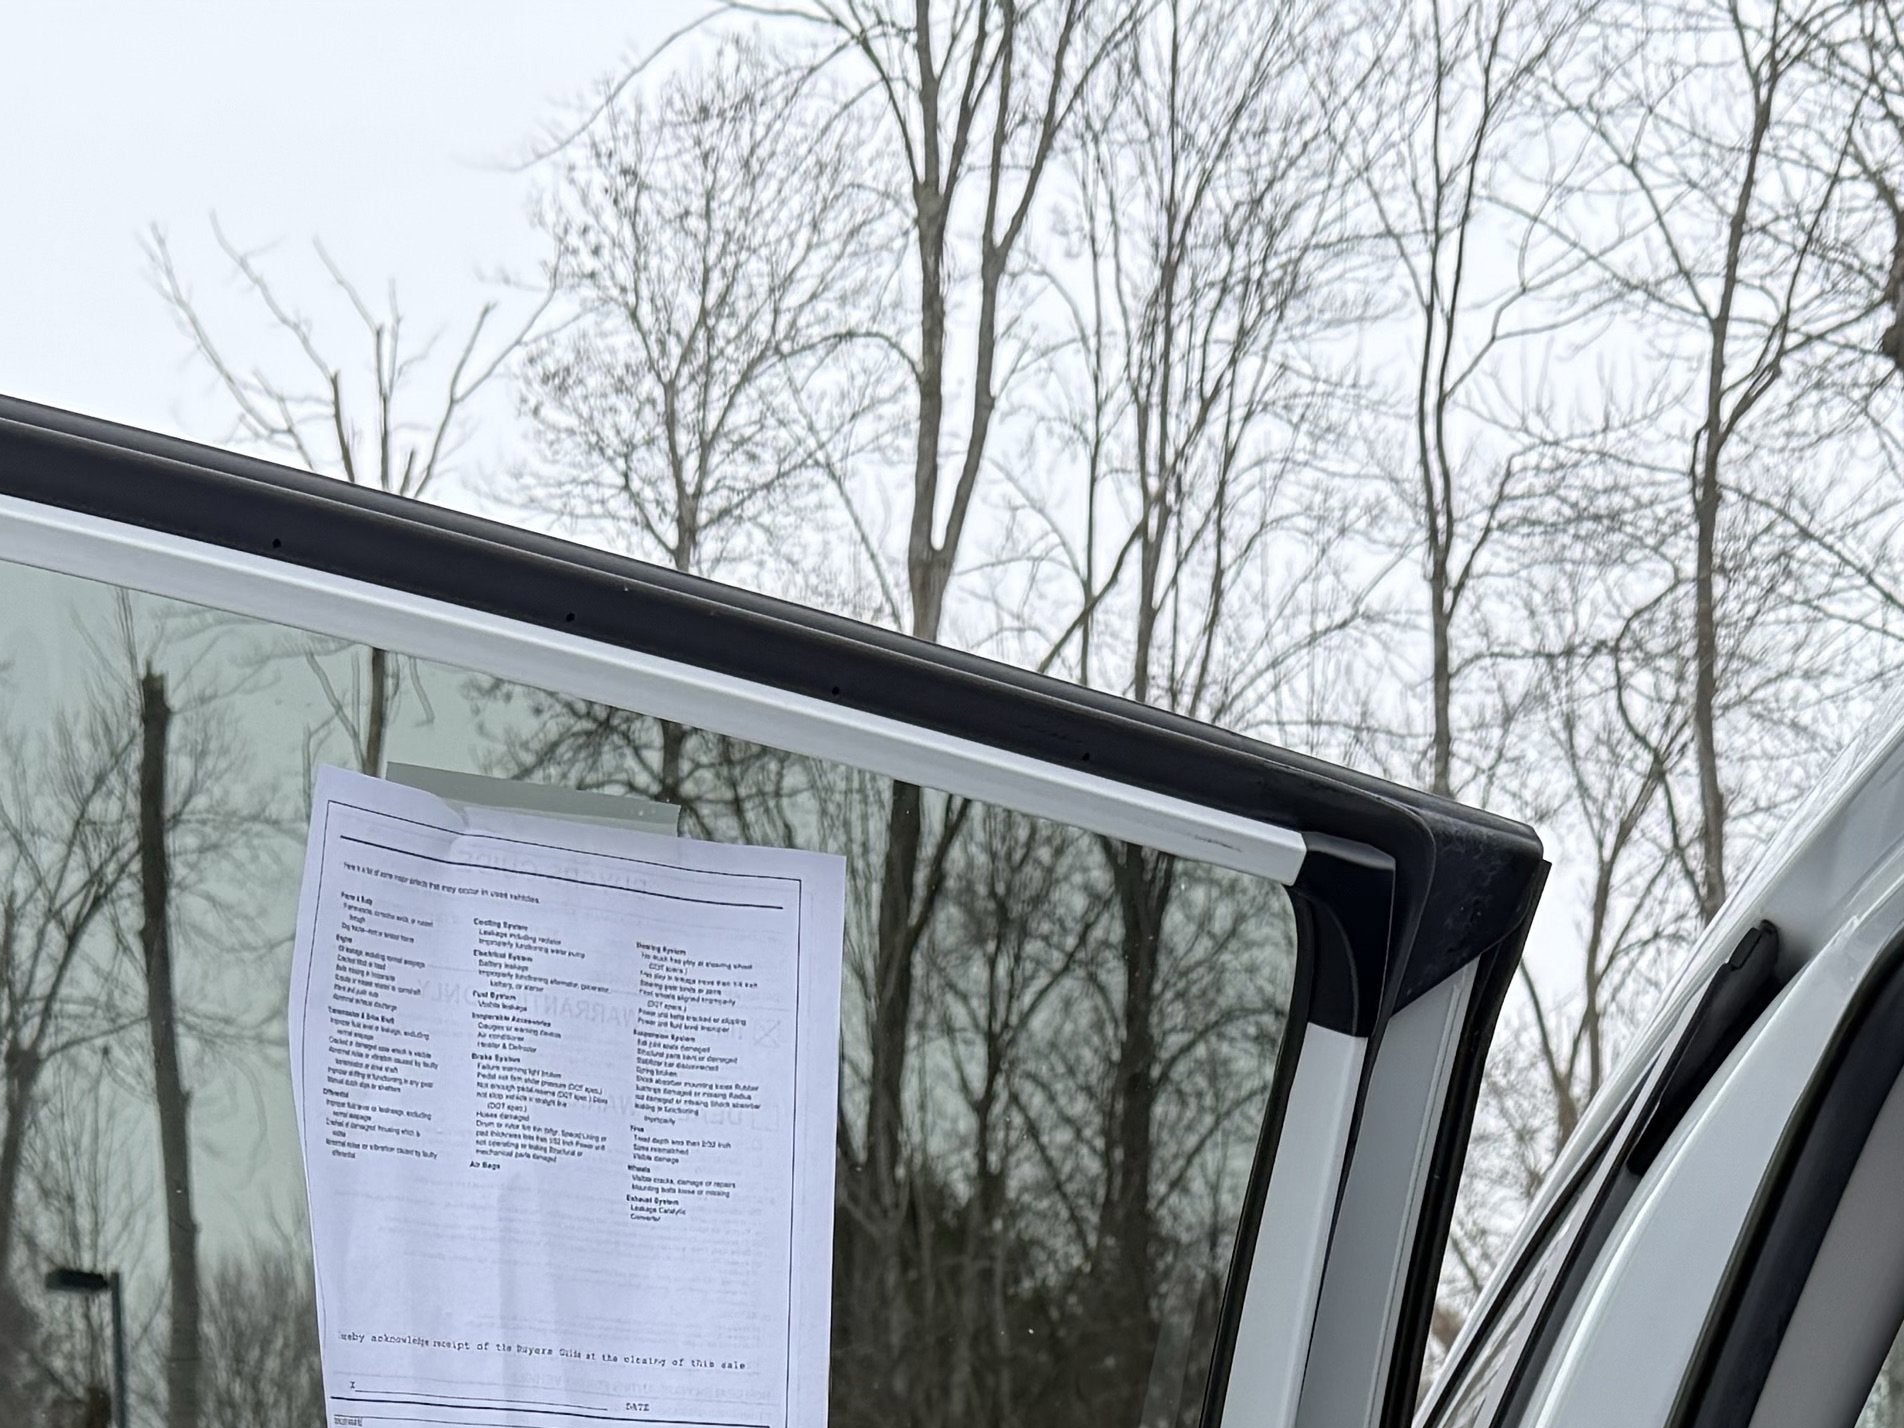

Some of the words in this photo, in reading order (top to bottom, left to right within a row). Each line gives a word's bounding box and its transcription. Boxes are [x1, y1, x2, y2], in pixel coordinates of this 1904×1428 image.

[602, 1354, 618, 1363] the
[691, 1358, 715, 1368] this
[721, 1361, 746, 1370] sale
[625, 1402, 650, 1411] DATE
